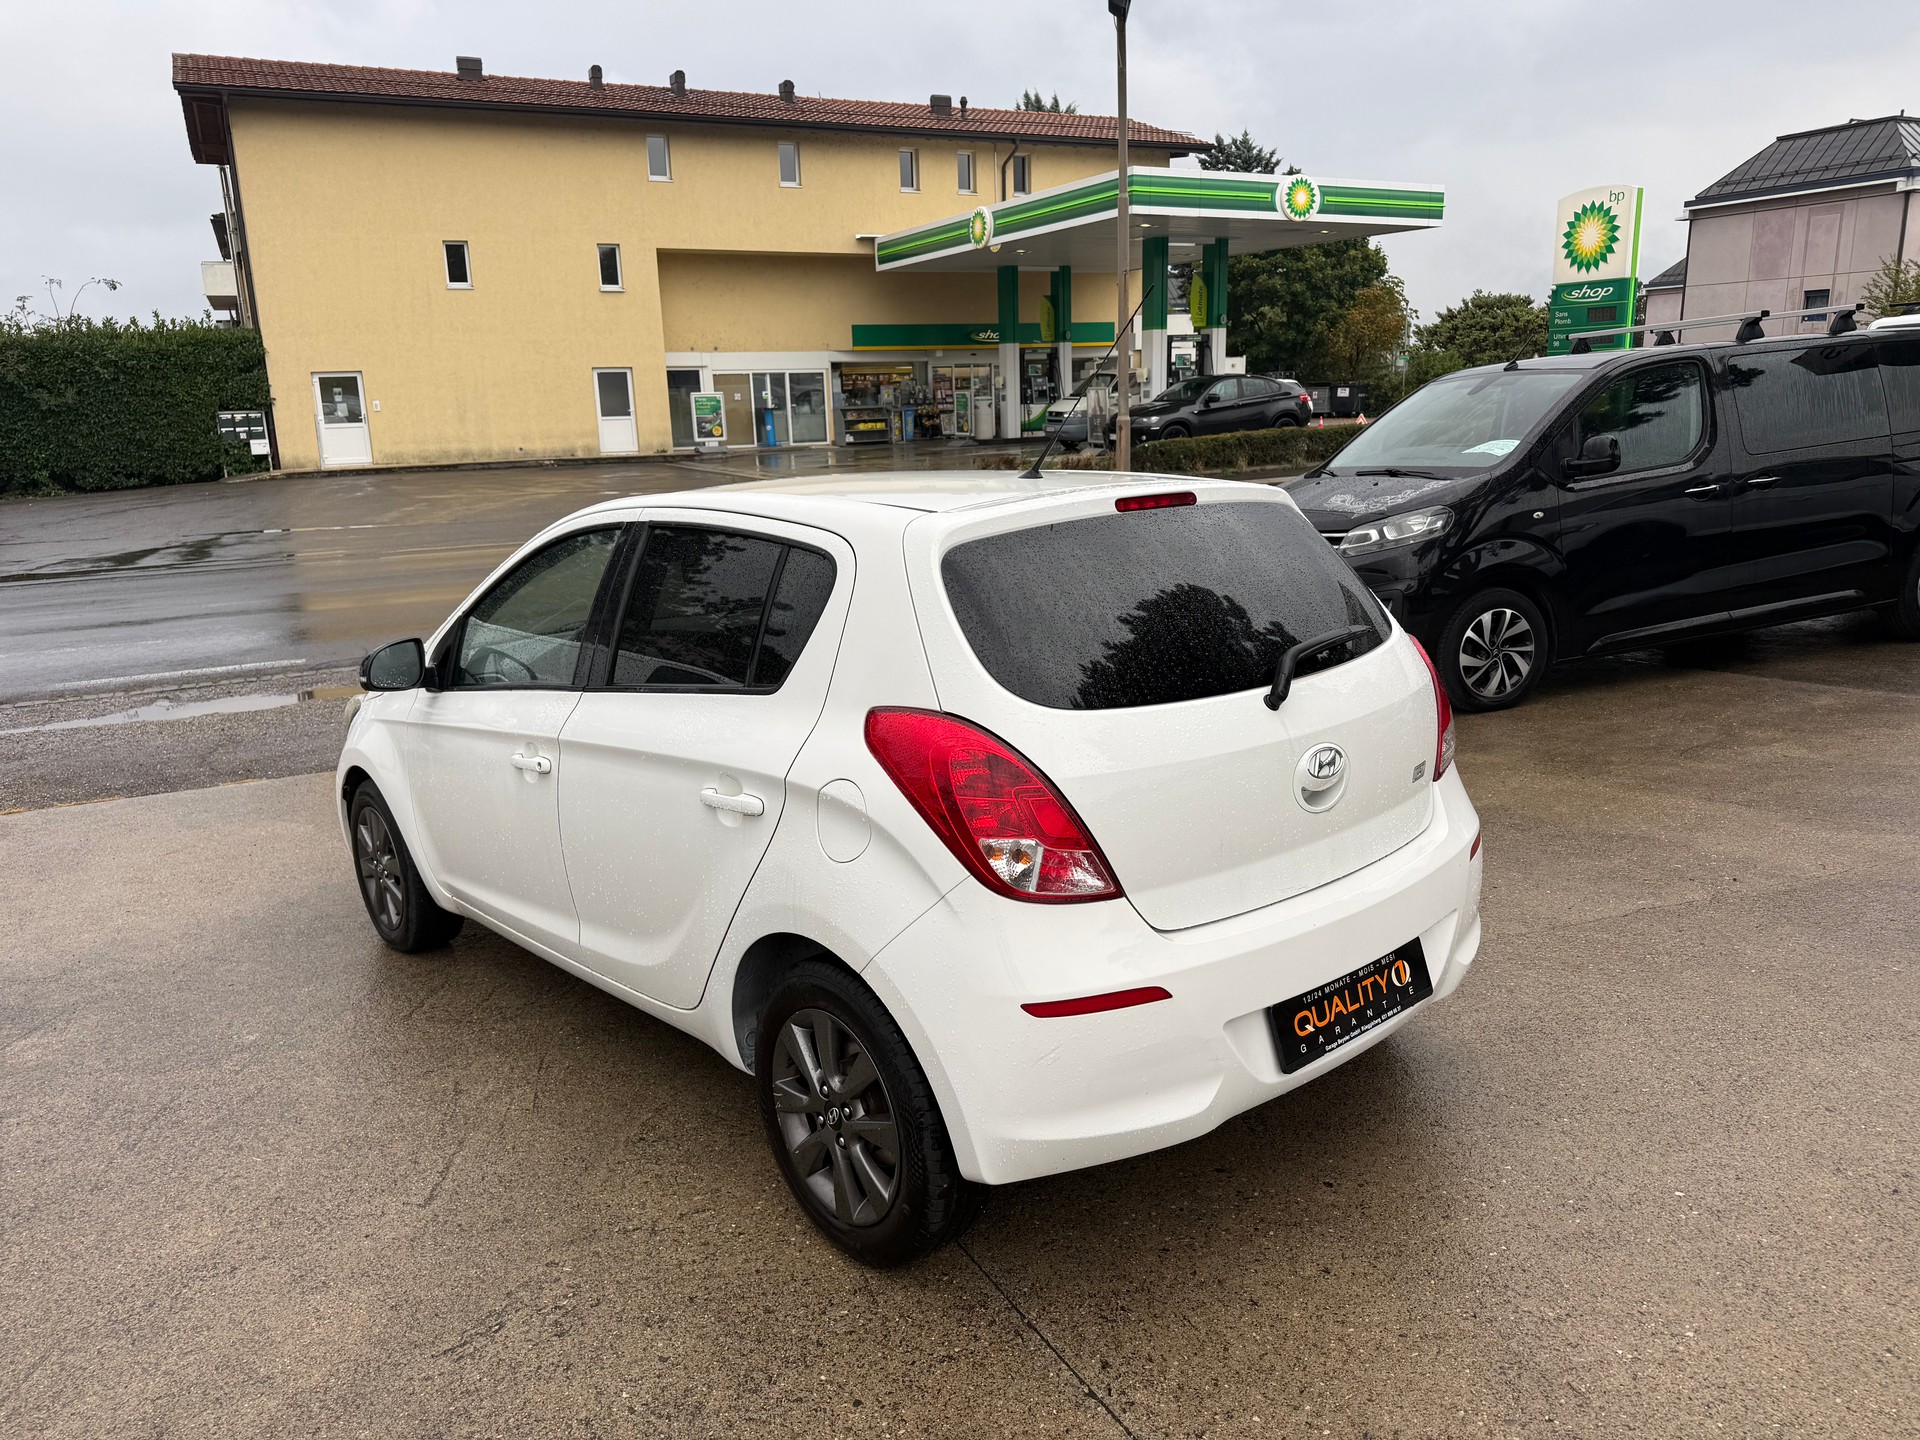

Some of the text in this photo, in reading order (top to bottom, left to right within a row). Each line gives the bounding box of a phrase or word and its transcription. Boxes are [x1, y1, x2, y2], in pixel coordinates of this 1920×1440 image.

[1609, 190, 1625, 205] bp
[1567, 285, 1614, 301] shop
[978, 329, 1000, 339] sho
[1303, 990, 1322, 1004] 12/24
[1324, 975, 1351, 993] MONATE
[1358, 964, 1375, 977] MOIS
[1381, 953, 1396, 966] MESI
[1294, 968, 1389, 1037] QUALITY
[1300, 986, 1415, 1053] GARANTIE
